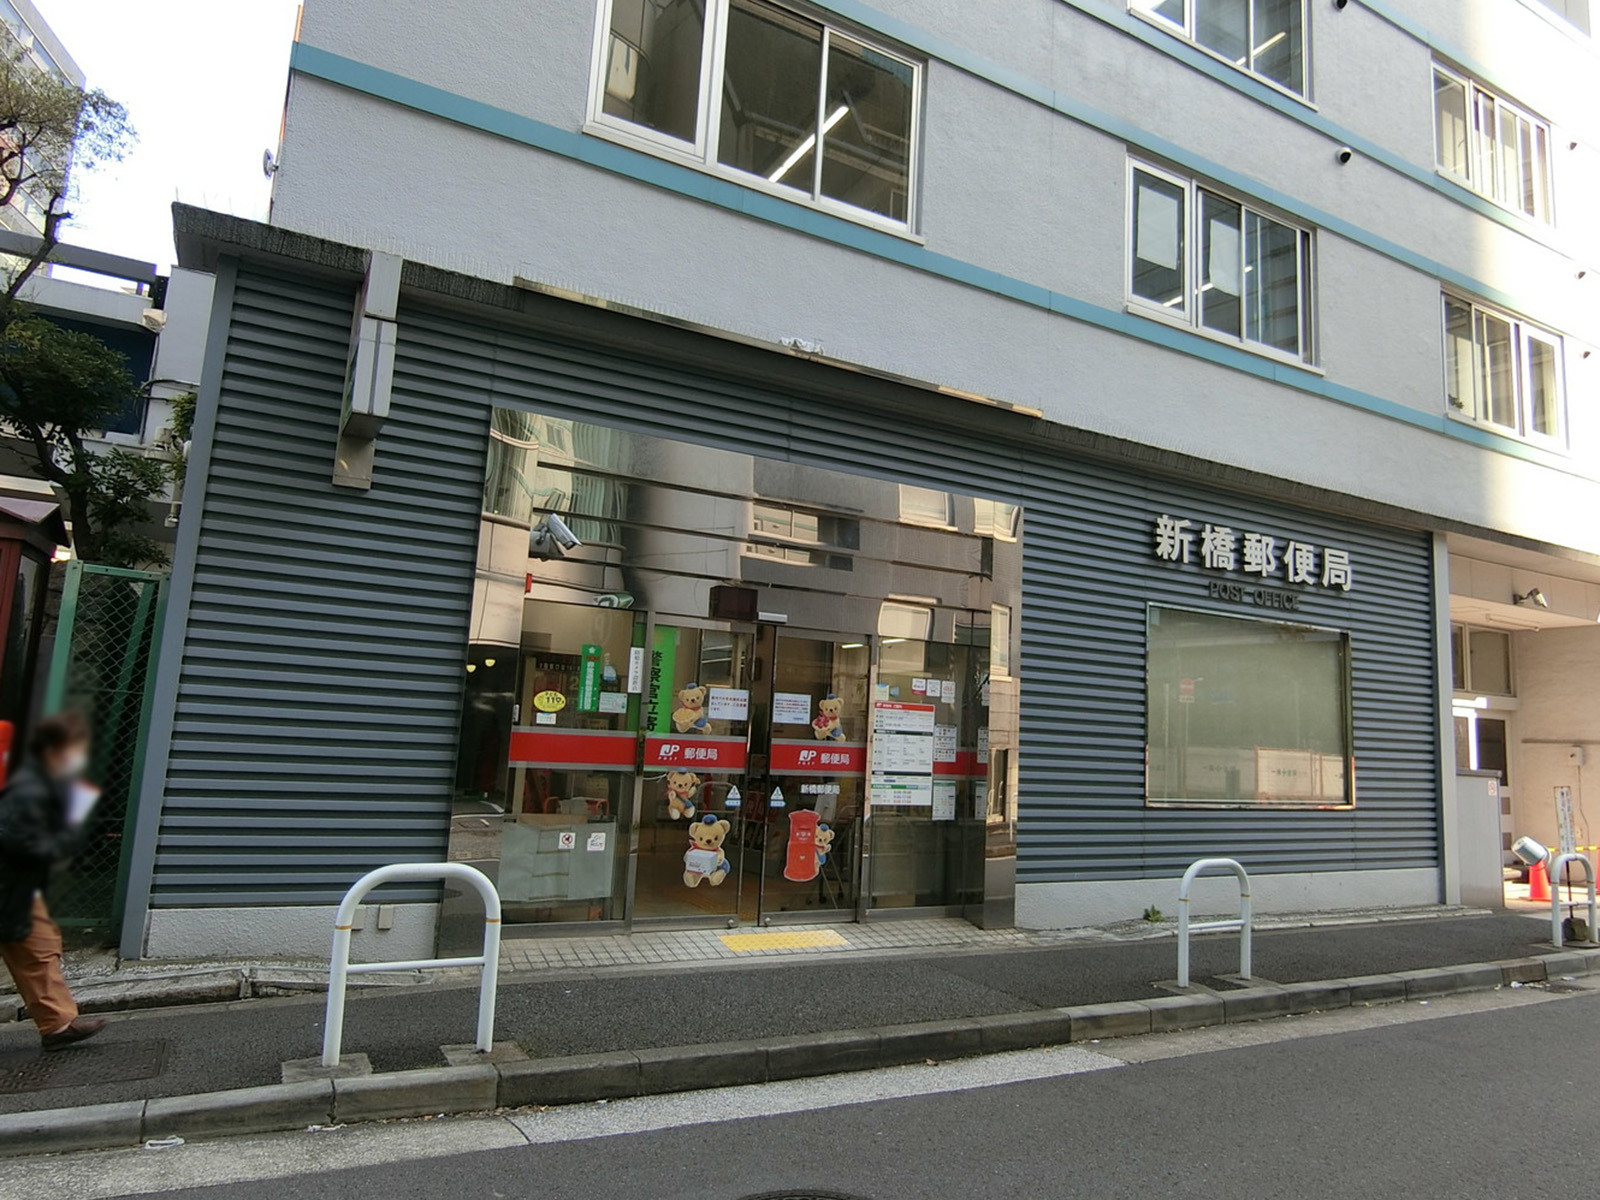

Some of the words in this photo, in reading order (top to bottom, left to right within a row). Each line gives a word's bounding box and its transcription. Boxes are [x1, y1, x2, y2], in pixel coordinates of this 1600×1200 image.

[1154, 514, 1352, 592] 新橋郵便局
[1209, 581, 1246, 602] POST
[1253, 590, 1300, 611] OFFICE
[684, 747, 718, 761] 郵便局
[820, 753, 850, 765] 郵便局
[800, 784, 841, 795] 新橋郵便局
